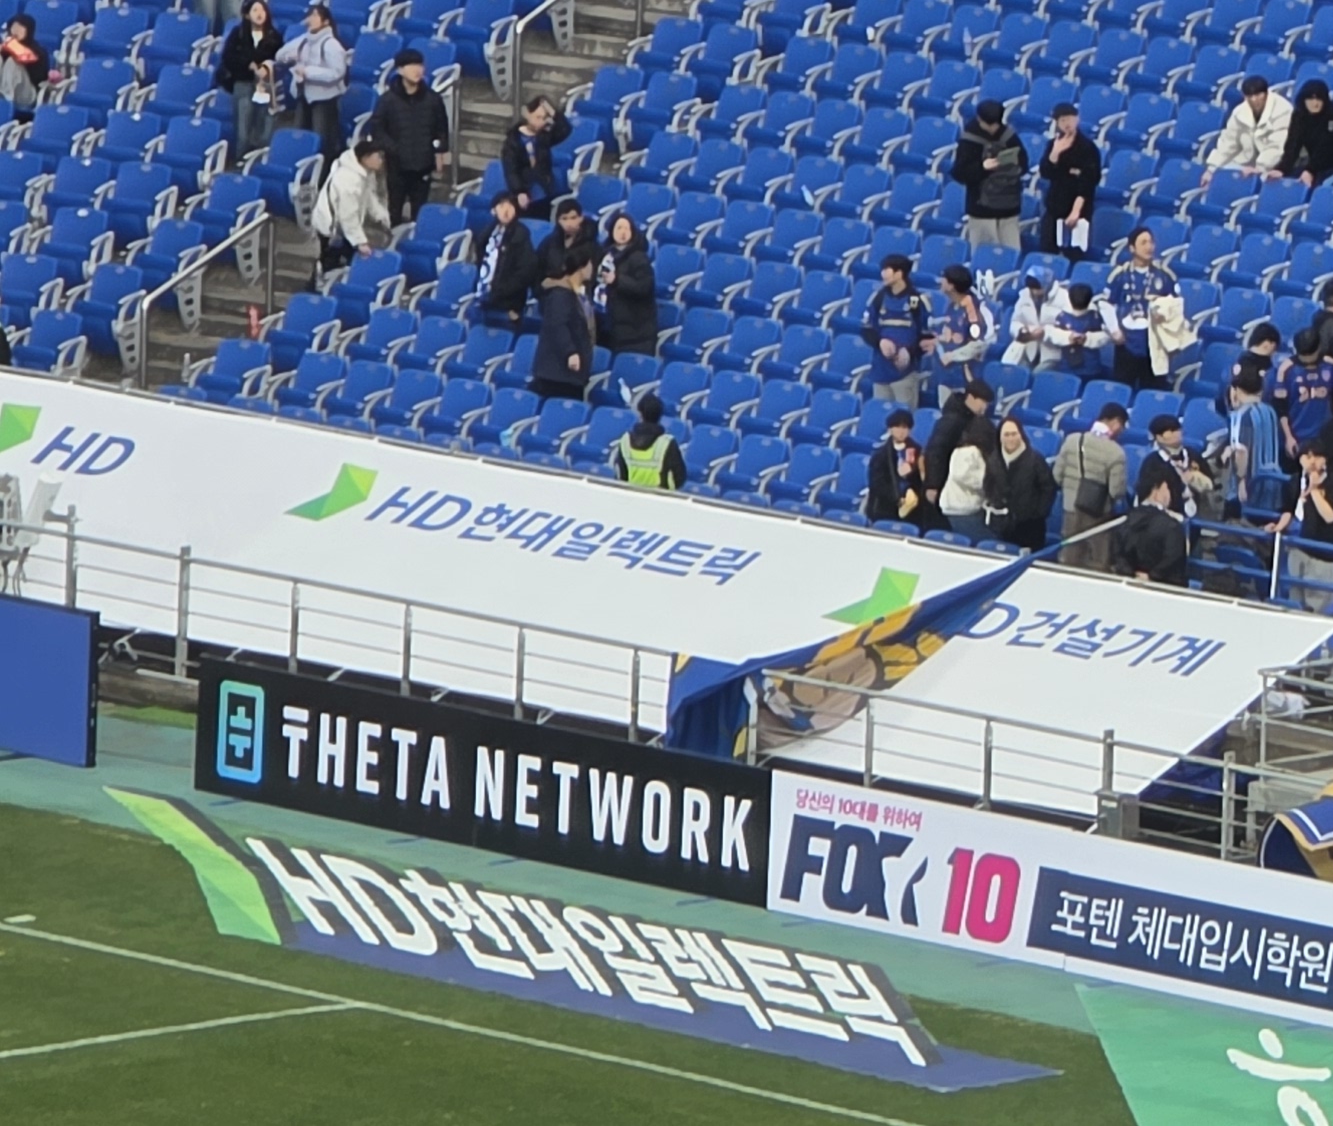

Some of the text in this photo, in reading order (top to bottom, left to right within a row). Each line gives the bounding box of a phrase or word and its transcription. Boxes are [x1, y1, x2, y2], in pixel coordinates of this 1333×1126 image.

[30, 426, 135, 475] HD
[282, 705, 753, 872] THETA NETWORK
[796, 788, 924, 832] 당신의 10대를 위하여
[941, 847, 1021, 944] 10
[1050, 890, 1124, 950] 포텐
